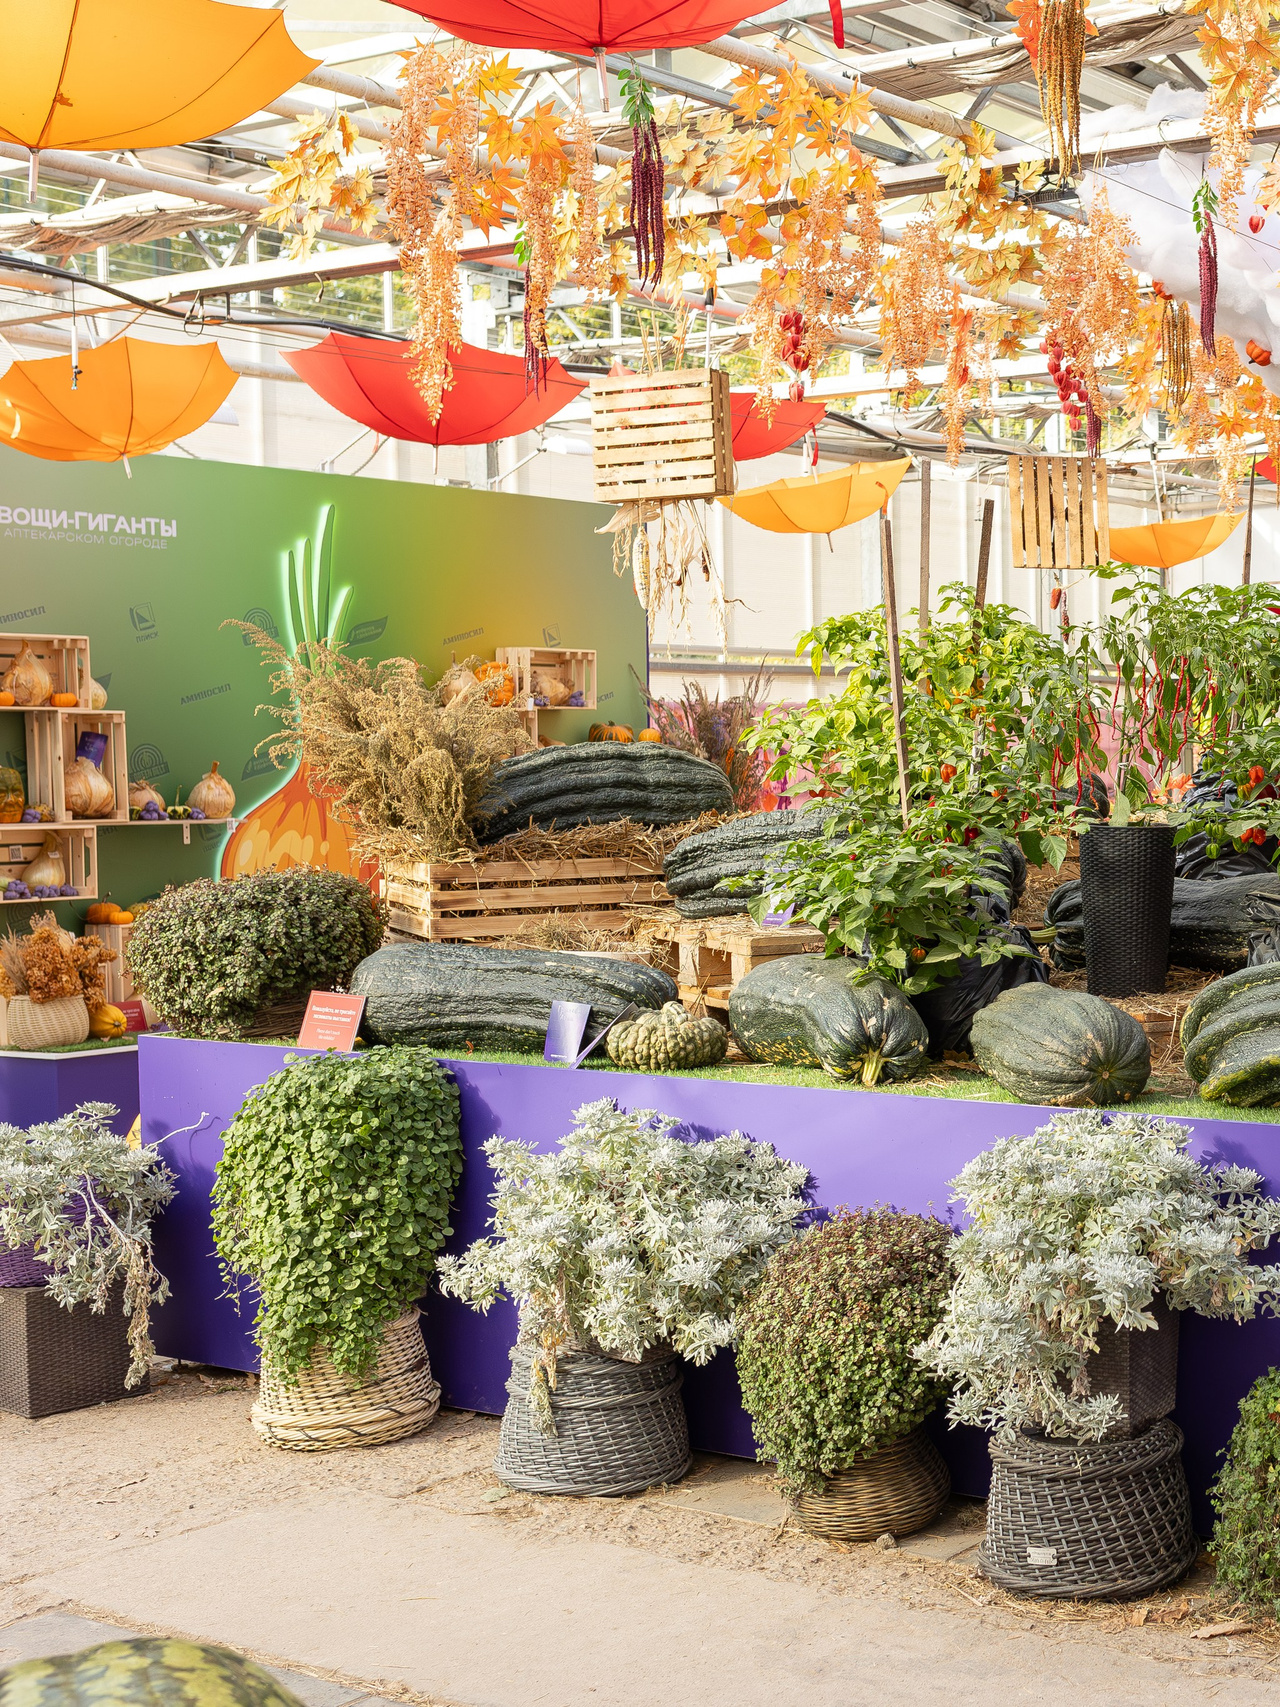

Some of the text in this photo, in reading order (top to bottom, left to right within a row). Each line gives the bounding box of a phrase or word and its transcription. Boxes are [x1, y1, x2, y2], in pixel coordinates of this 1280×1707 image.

[4, 527, 168, 550] АПТЕКАРСКОМ ОГОРОДЕ
[442, 627, 485, 646] АМИНОСИЛ
[180, 683, 232, 705] АМИНОСИЛ
